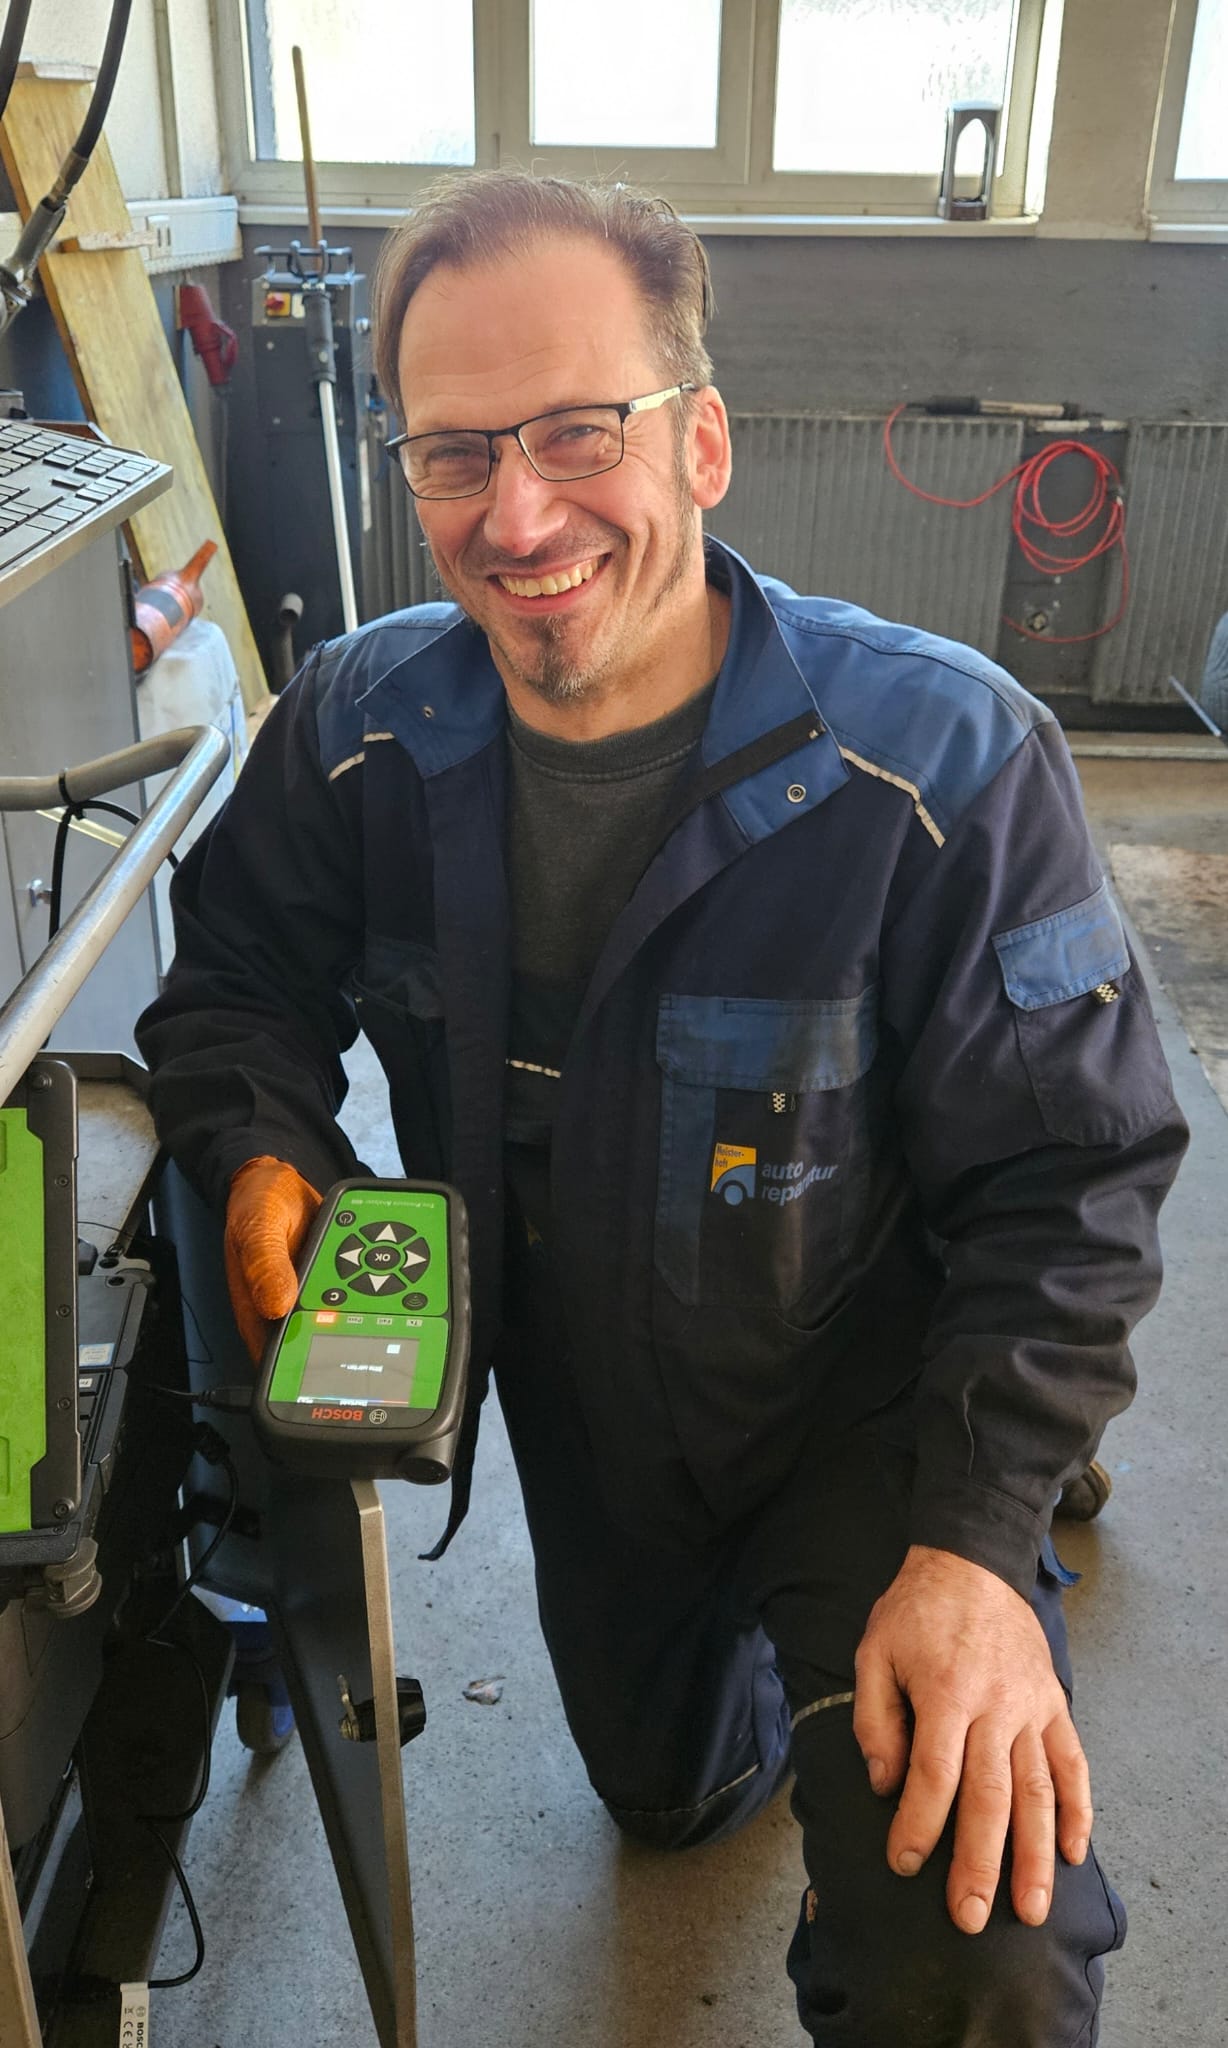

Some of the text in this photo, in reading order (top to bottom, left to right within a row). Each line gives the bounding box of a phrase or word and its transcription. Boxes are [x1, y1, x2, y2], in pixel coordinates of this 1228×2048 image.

[762, 1160, 804, 1180] auto
[374, 1252, 391, 1262] OK
[330, 1291, 340, 1301] C
[311, 1407, 363, 1421] BOSCH
